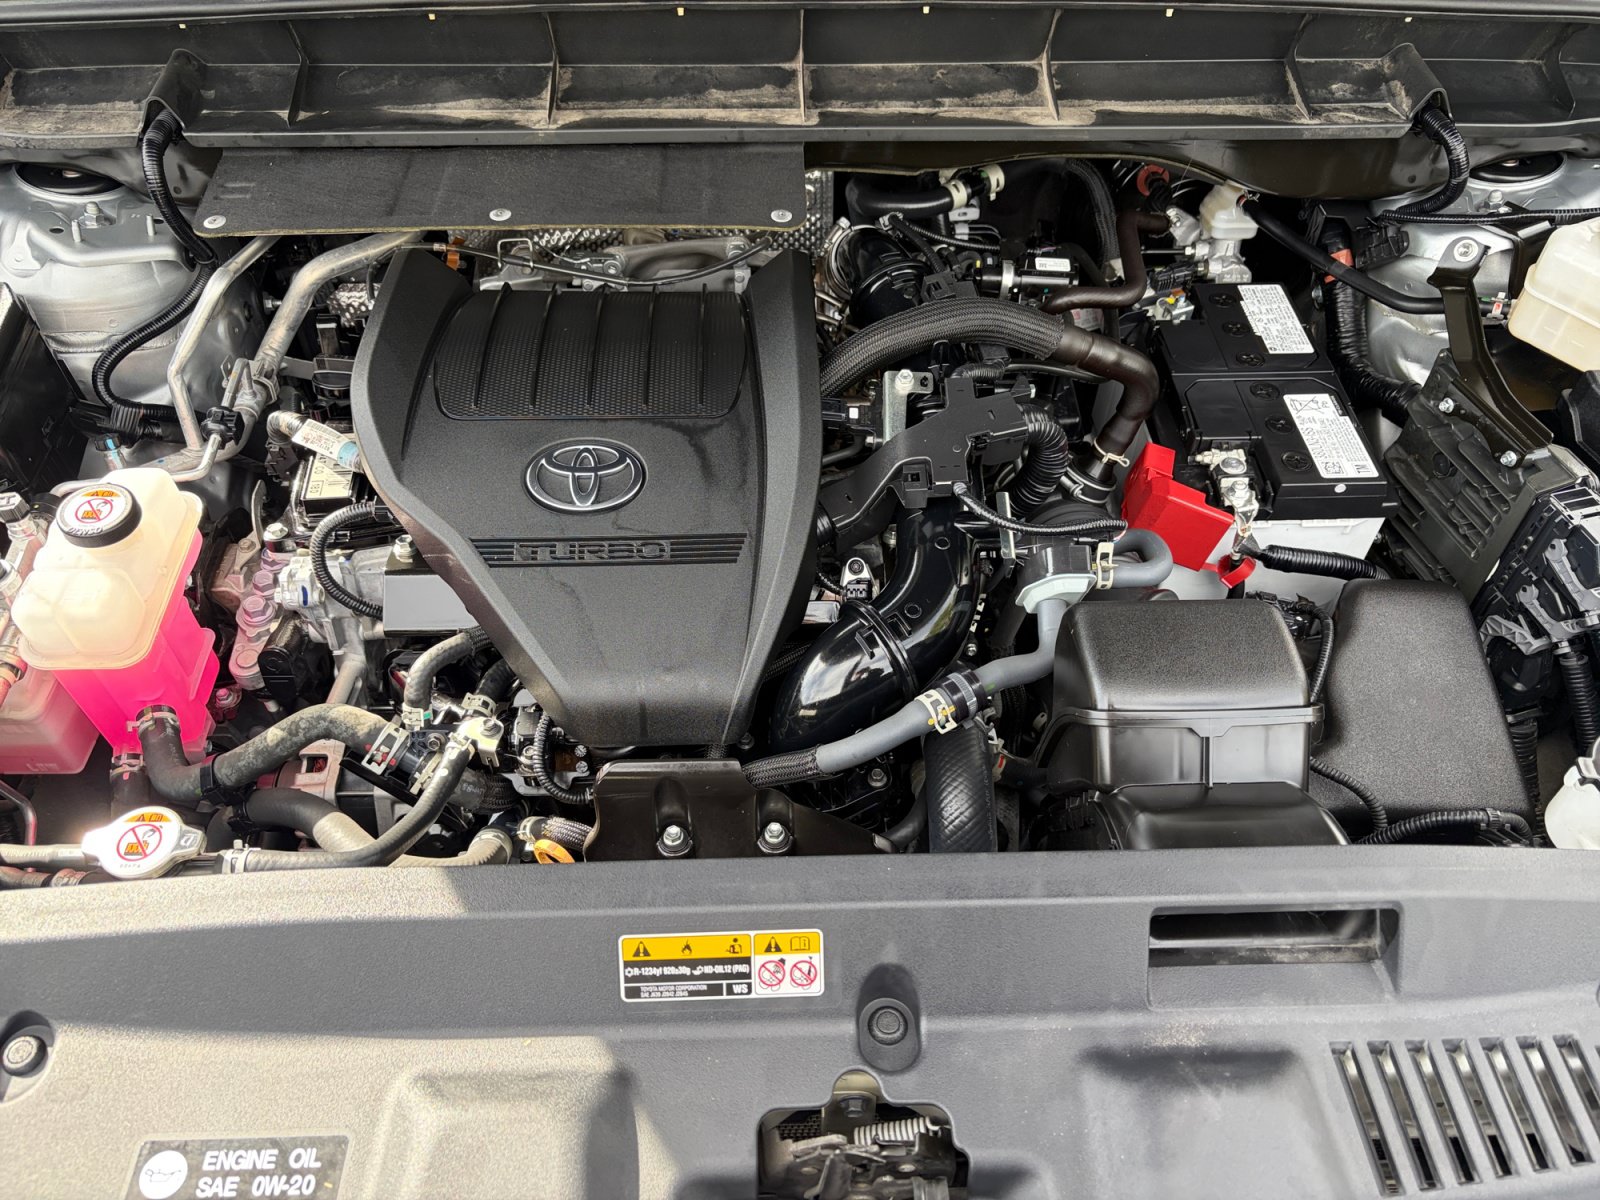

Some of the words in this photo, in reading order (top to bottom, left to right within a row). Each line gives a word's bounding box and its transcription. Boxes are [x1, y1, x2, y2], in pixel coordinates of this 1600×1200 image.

[512, 541, 672, 562] TURBO
[732, 983, 749, 994] WS
[202, 1148, 279, 1171] ENGINE
[288, 1147, 322, 1169] OIL
[195, 1176, 241, 1198] SAE
[251, 1174, 317, 1198] 0W-20
